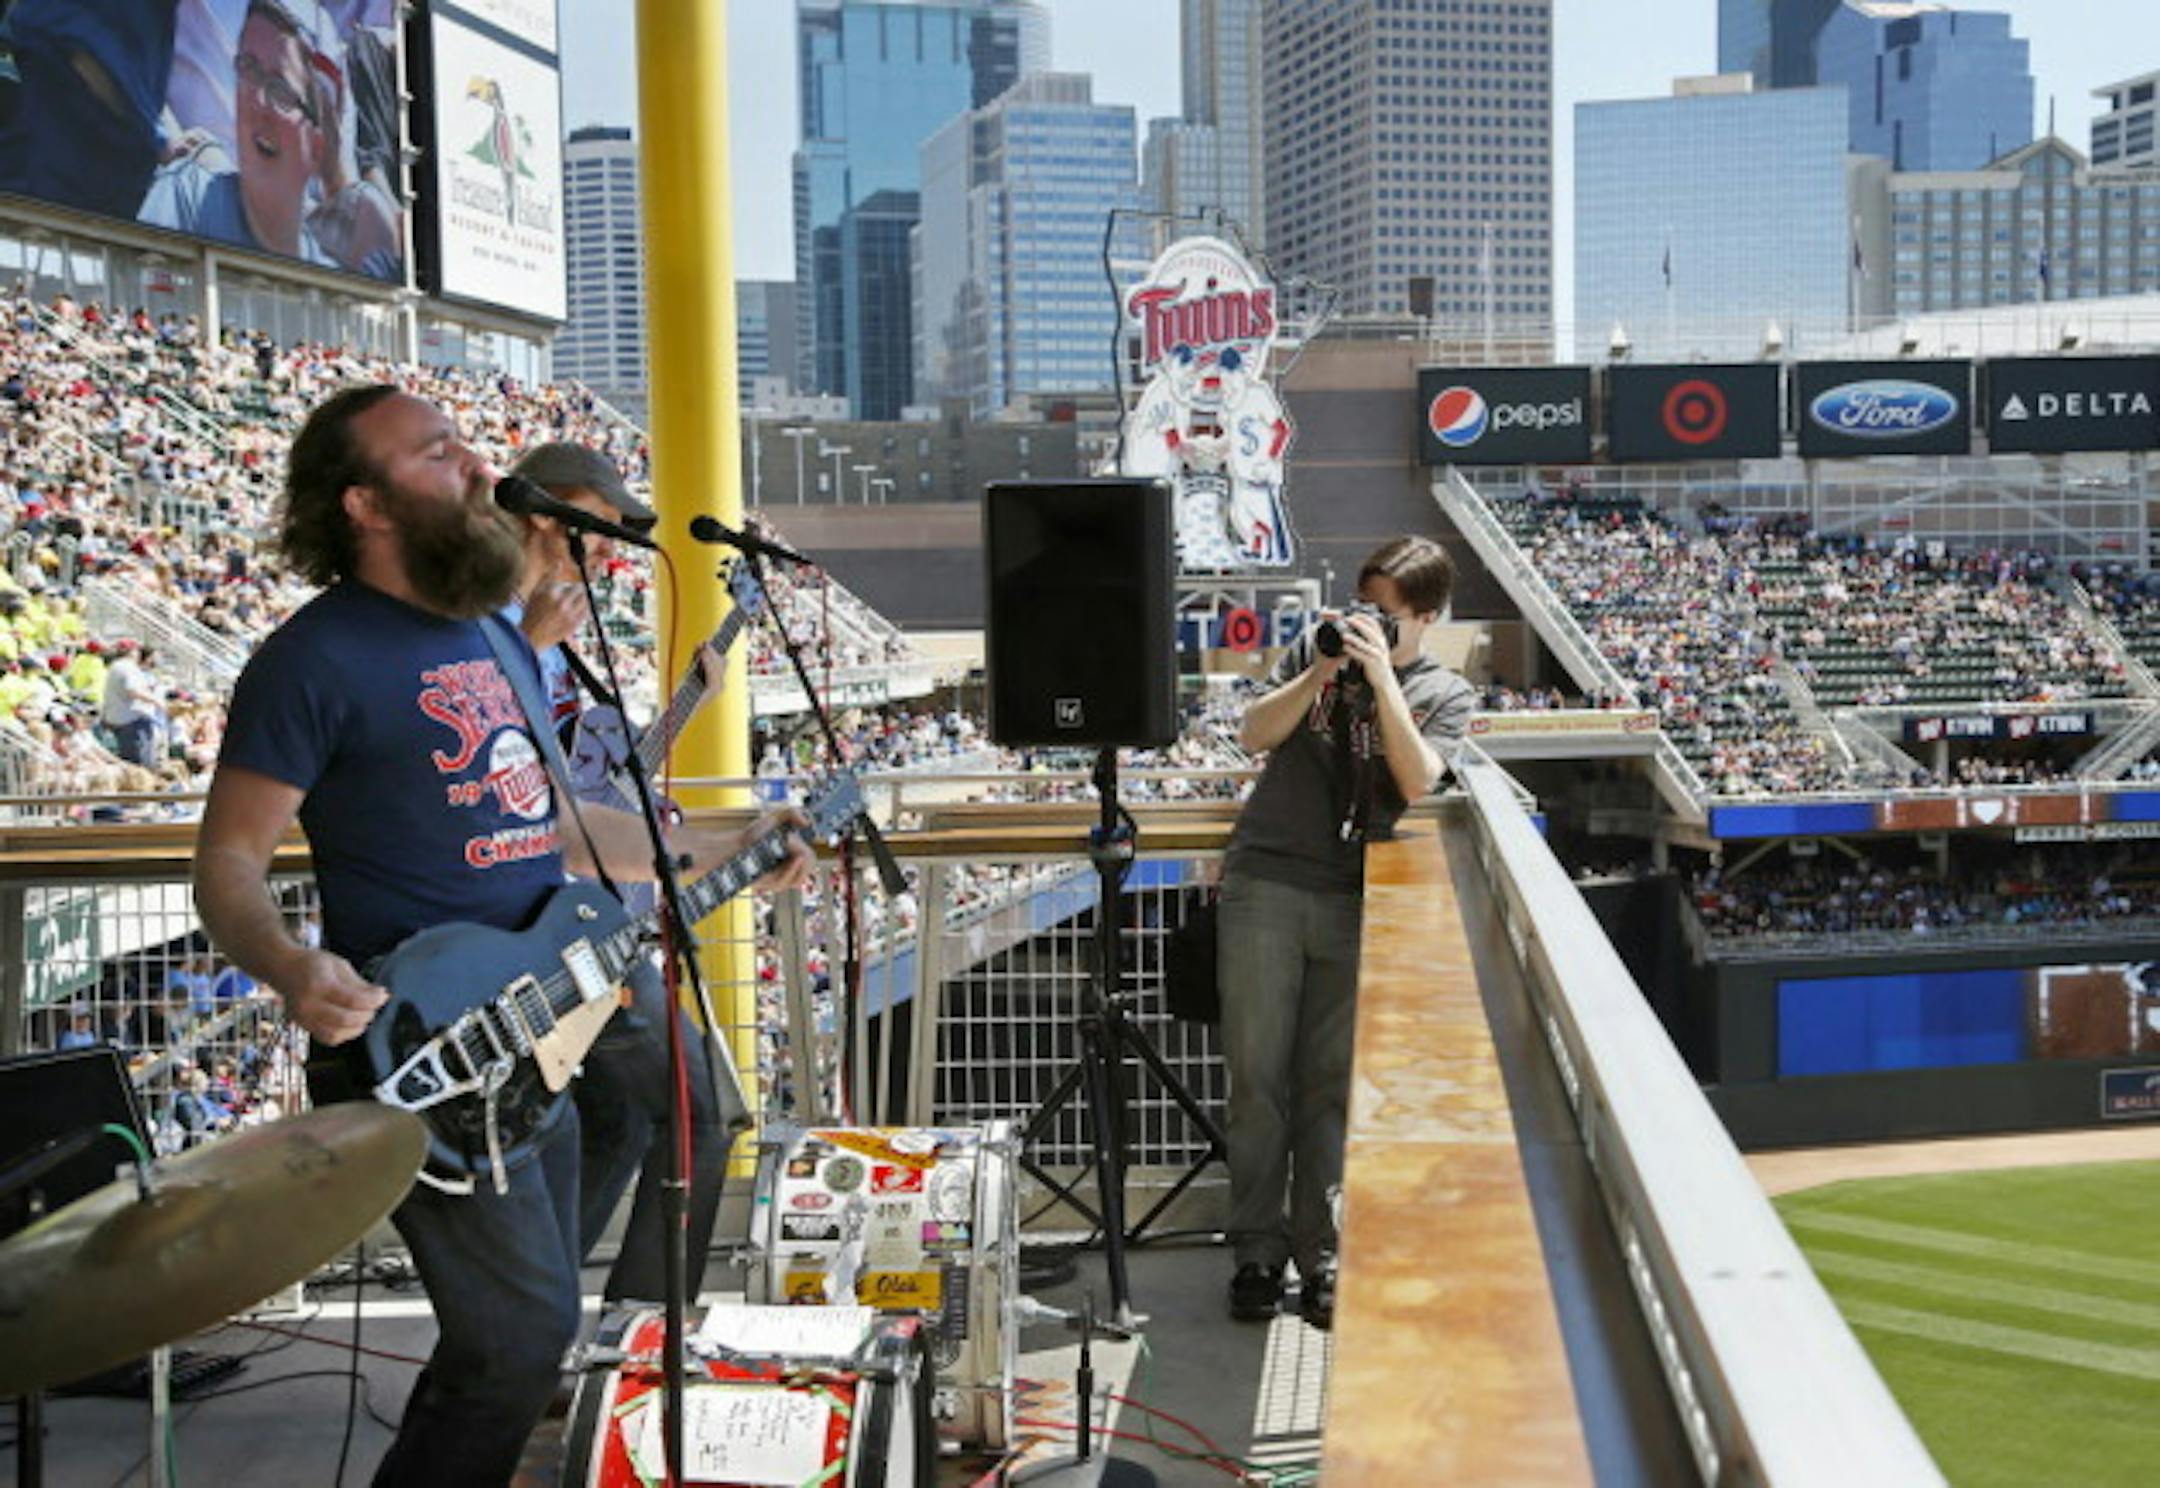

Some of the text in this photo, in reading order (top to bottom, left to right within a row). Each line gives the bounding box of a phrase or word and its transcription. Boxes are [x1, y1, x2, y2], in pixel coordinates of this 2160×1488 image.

[1129, 277, 1274, 366] Twins
[1492, 397, 1583, 431] pepsi
[1840, 391, 1928, 427] Ford
[2038, 392, 2152, 417] DELTA
